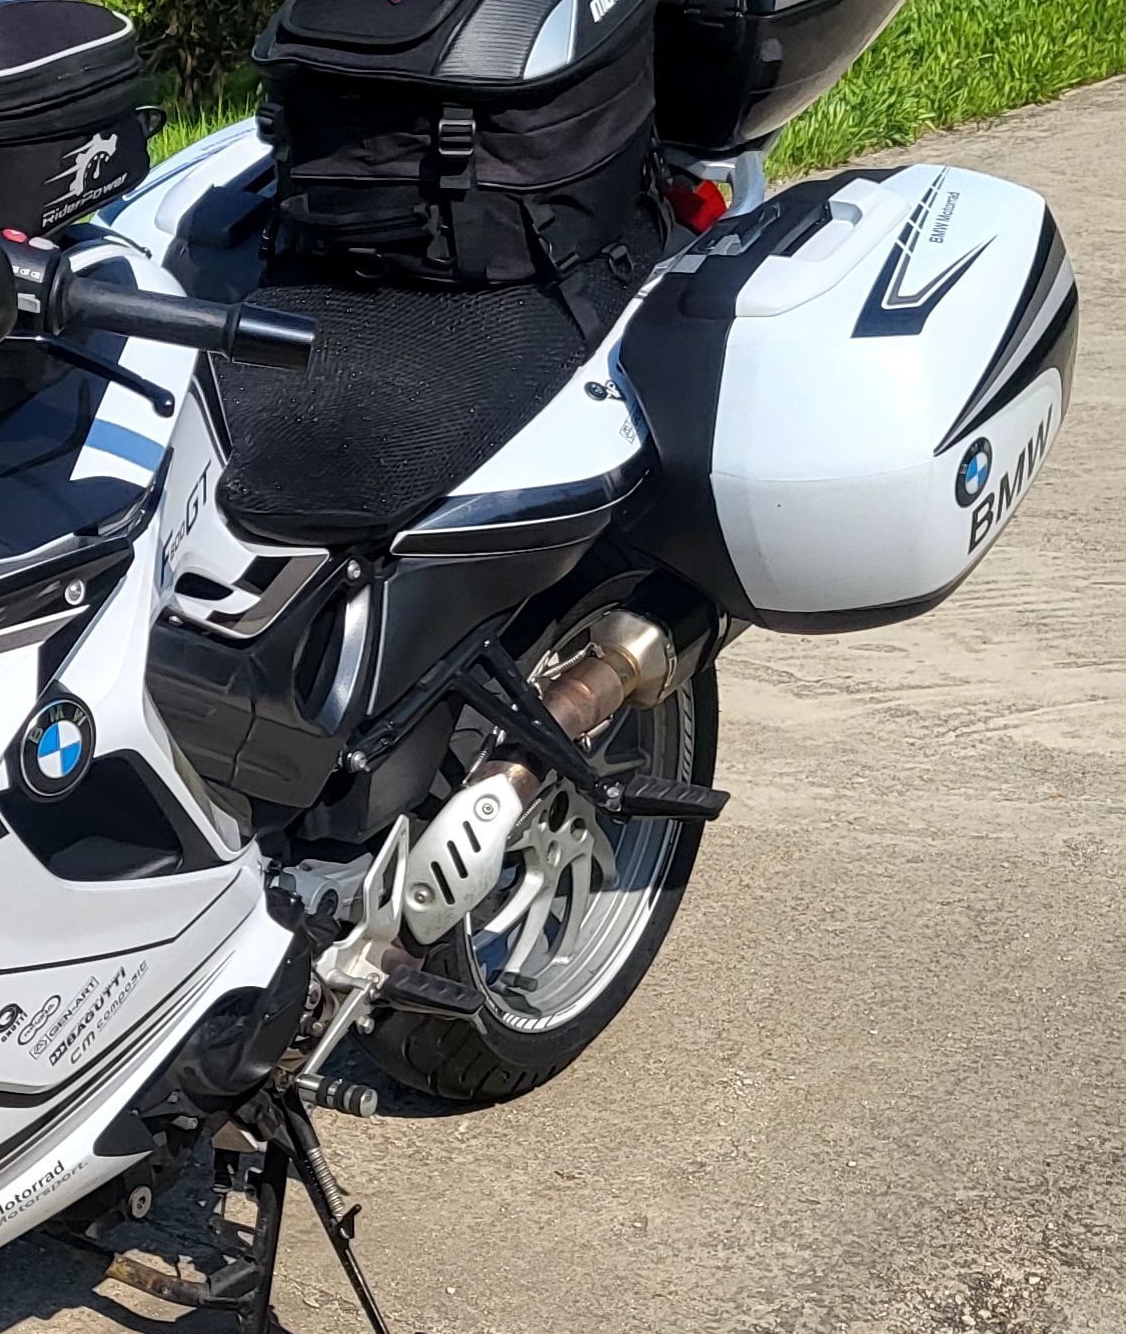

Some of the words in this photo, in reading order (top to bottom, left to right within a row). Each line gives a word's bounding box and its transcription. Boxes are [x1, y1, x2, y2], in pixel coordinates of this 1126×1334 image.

[929, 222, 949, 244] BMW
[968, 402, 1054, 555] BMW
[48, 980, 97, 1038] GEN-ART
[67, 966, 127, 1046] BAGUTTI
